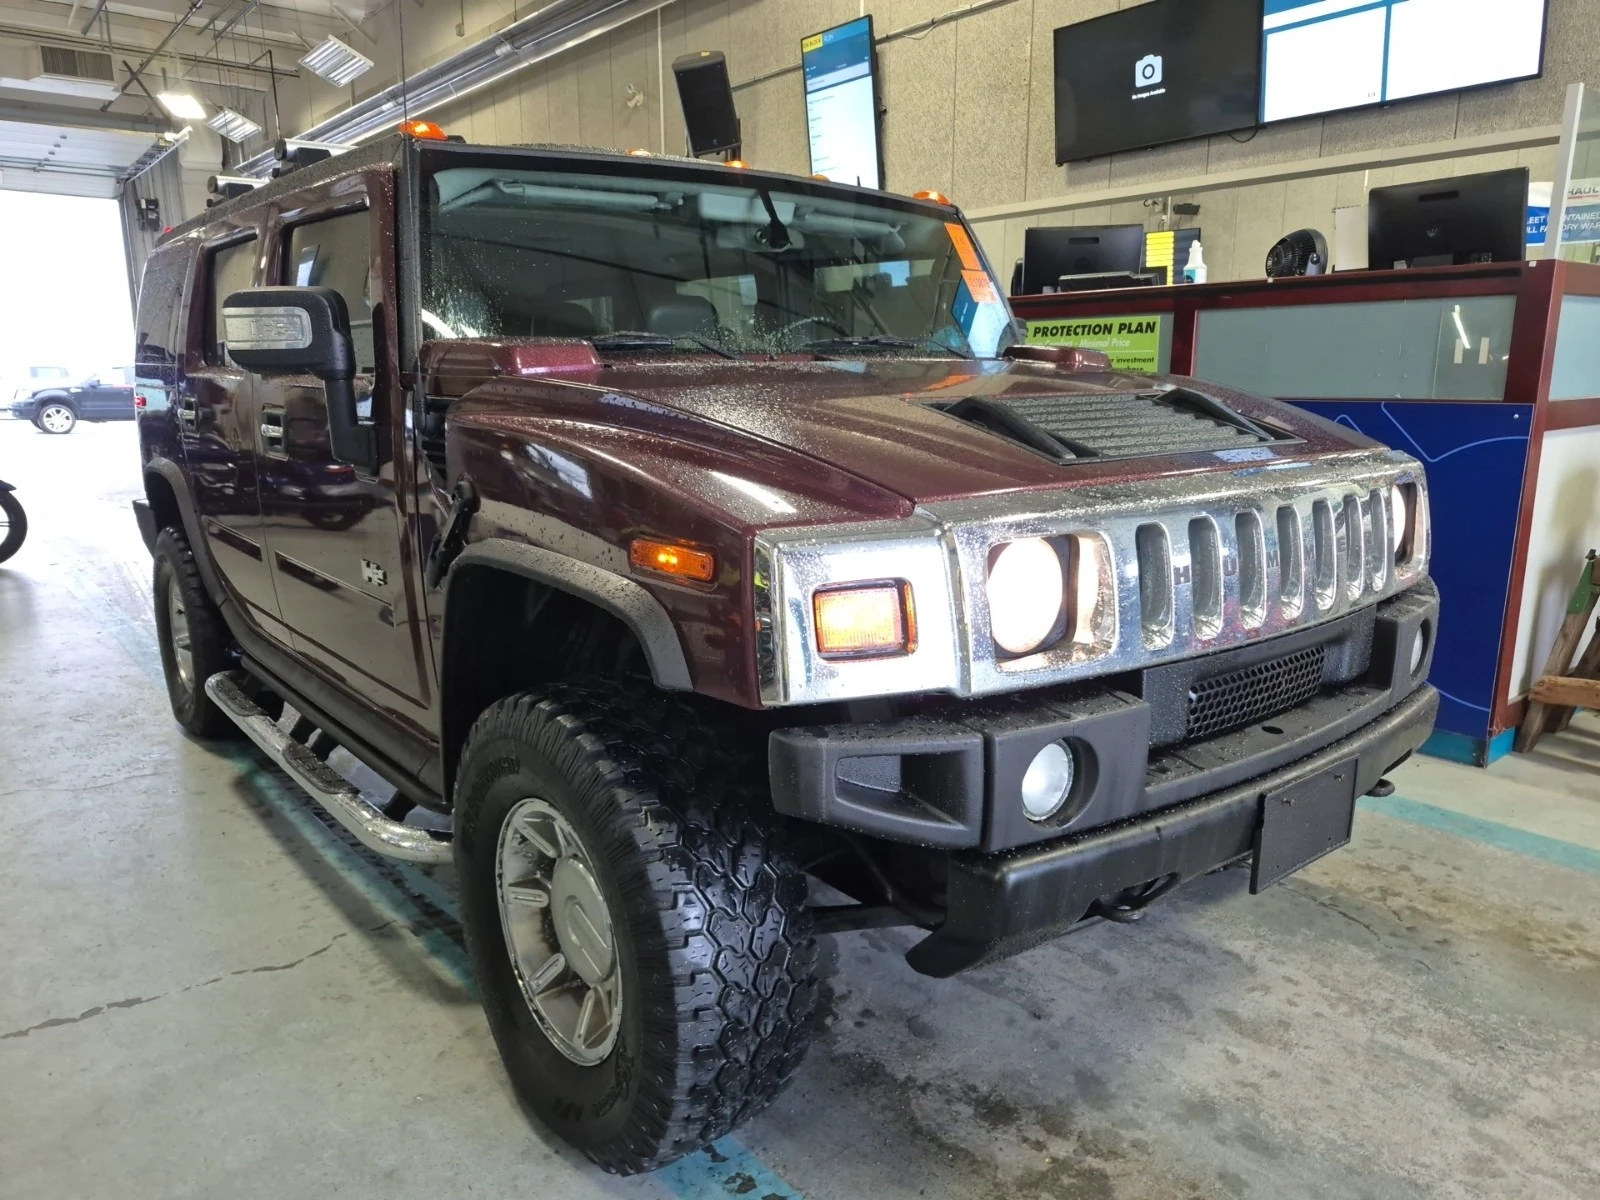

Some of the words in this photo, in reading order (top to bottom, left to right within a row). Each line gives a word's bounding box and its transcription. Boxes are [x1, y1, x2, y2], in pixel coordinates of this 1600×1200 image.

[1527, 215, 1546, 224] EET
[1033, 323, 1113, 337] PROTECTION
[1118, 321, 1156, 334] PLAN
[1080, 338, 1109, 347] Minimal
[1111, 337, 1130, 347] Price
